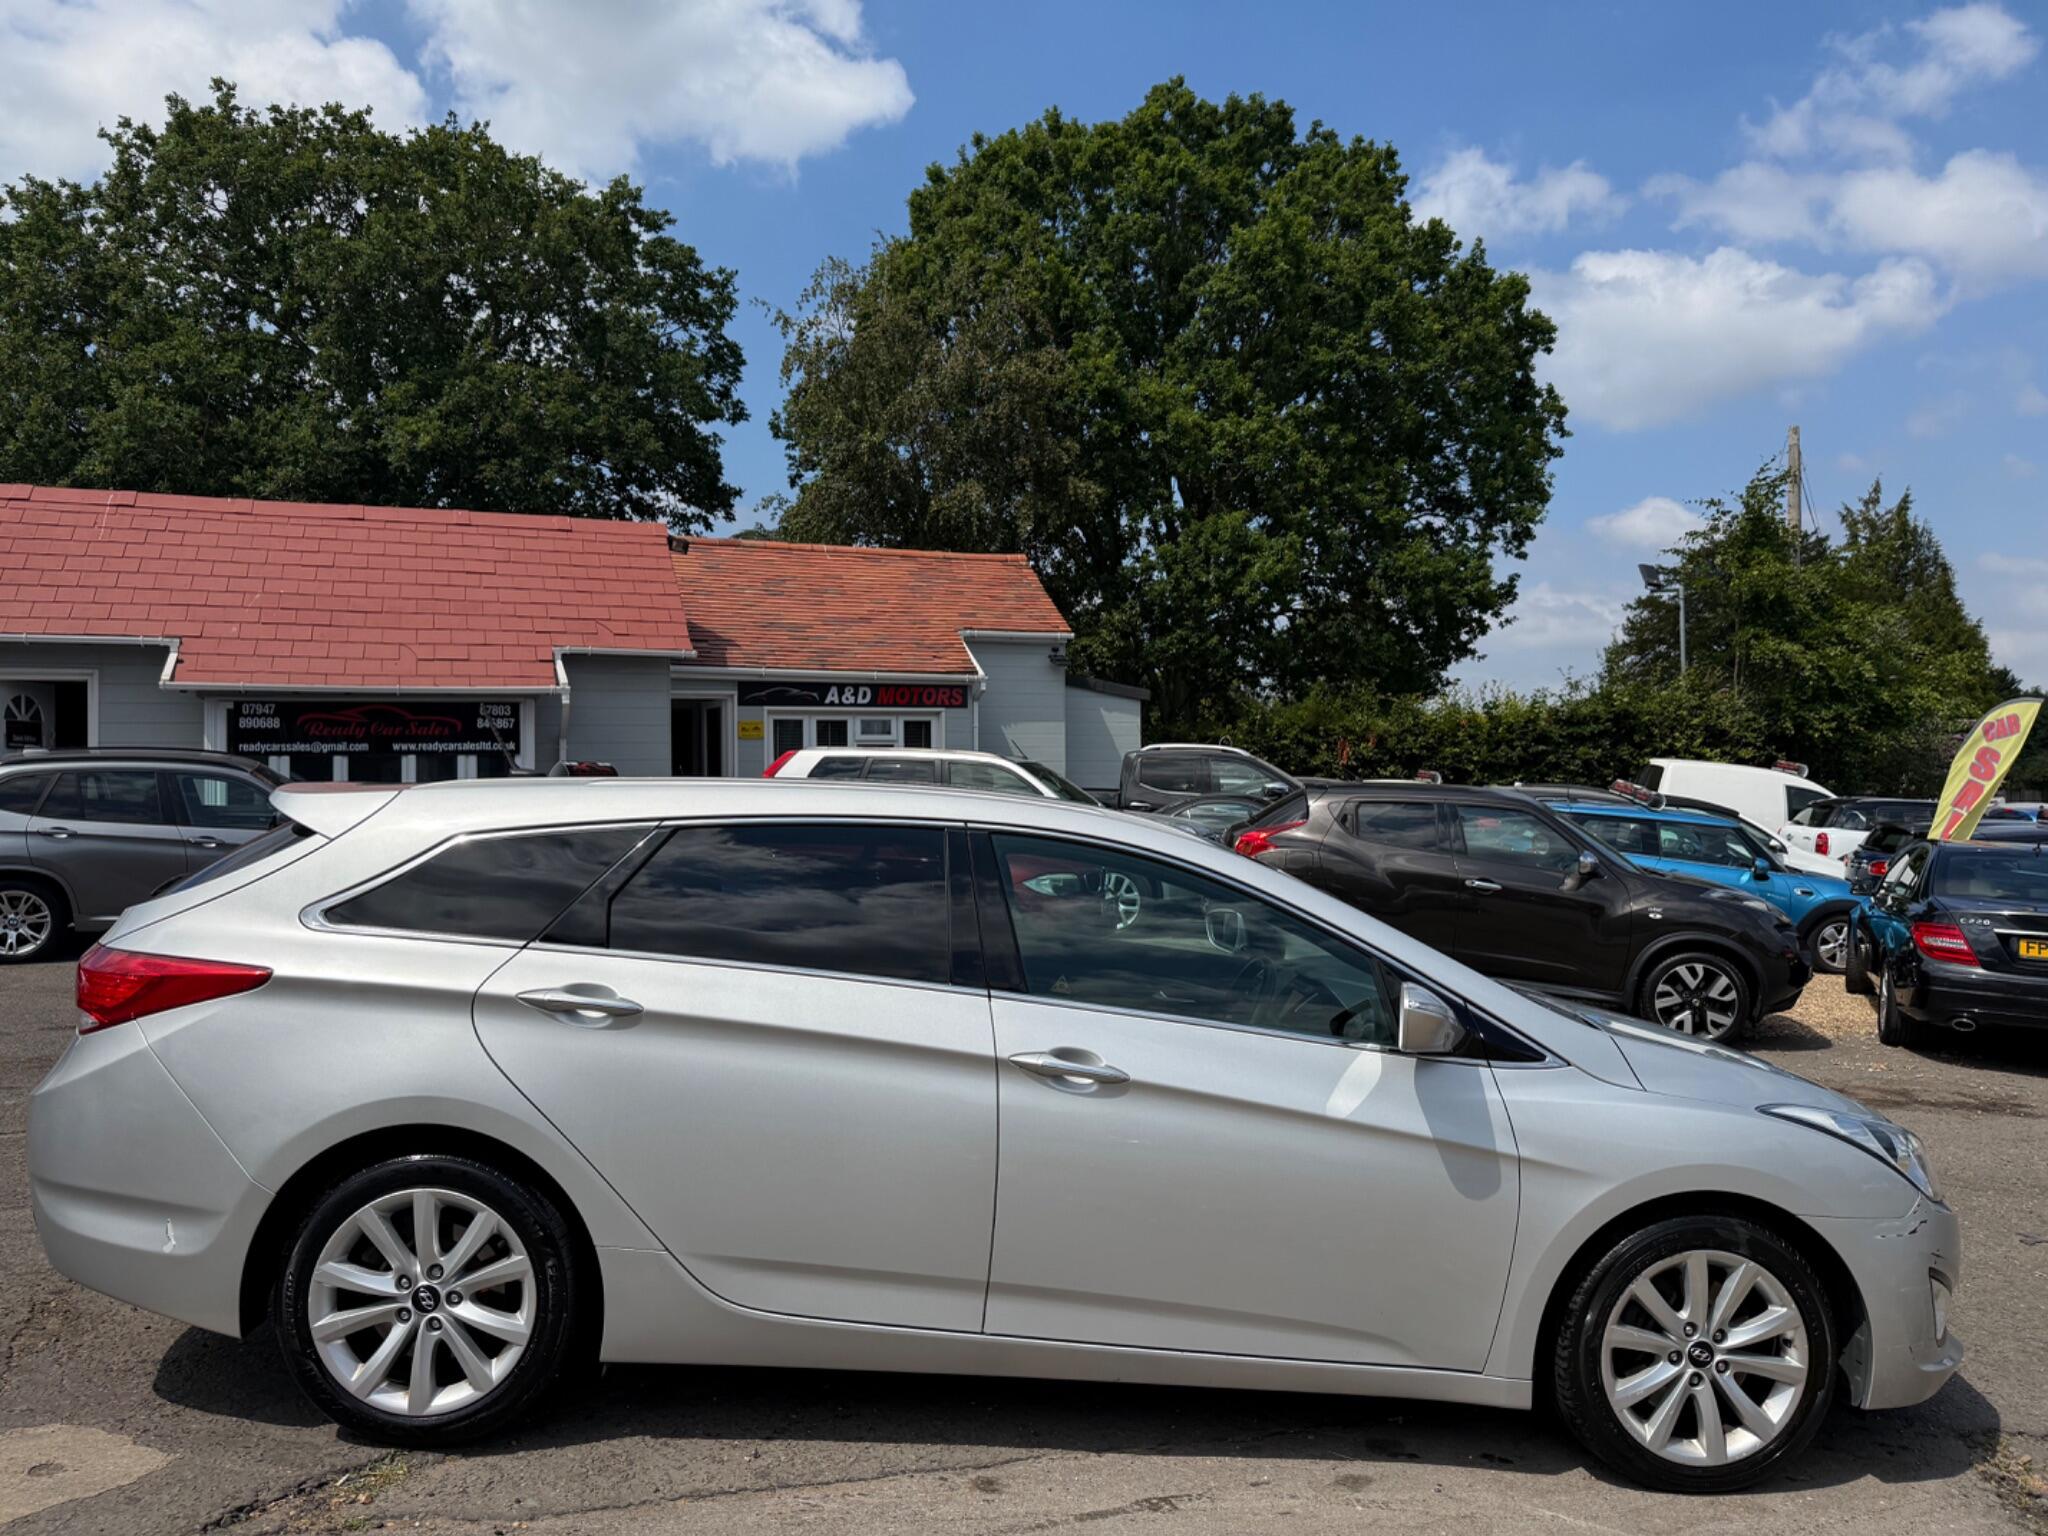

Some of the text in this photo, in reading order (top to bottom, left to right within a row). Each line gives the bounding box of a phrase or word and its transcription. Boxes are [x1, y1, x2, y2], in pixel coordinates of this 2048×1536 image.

[824, 685, 965, 706] A&D MOTORS
[241, 703, 276, 716] 07947
[303, 719, 451, 738] Ready Car Sales
[477, 717, 515, 729] 84867
[1981, 713, 2021, 742] CAR
[392, 740, 516, 753] www.readycarsalesltd.couk
